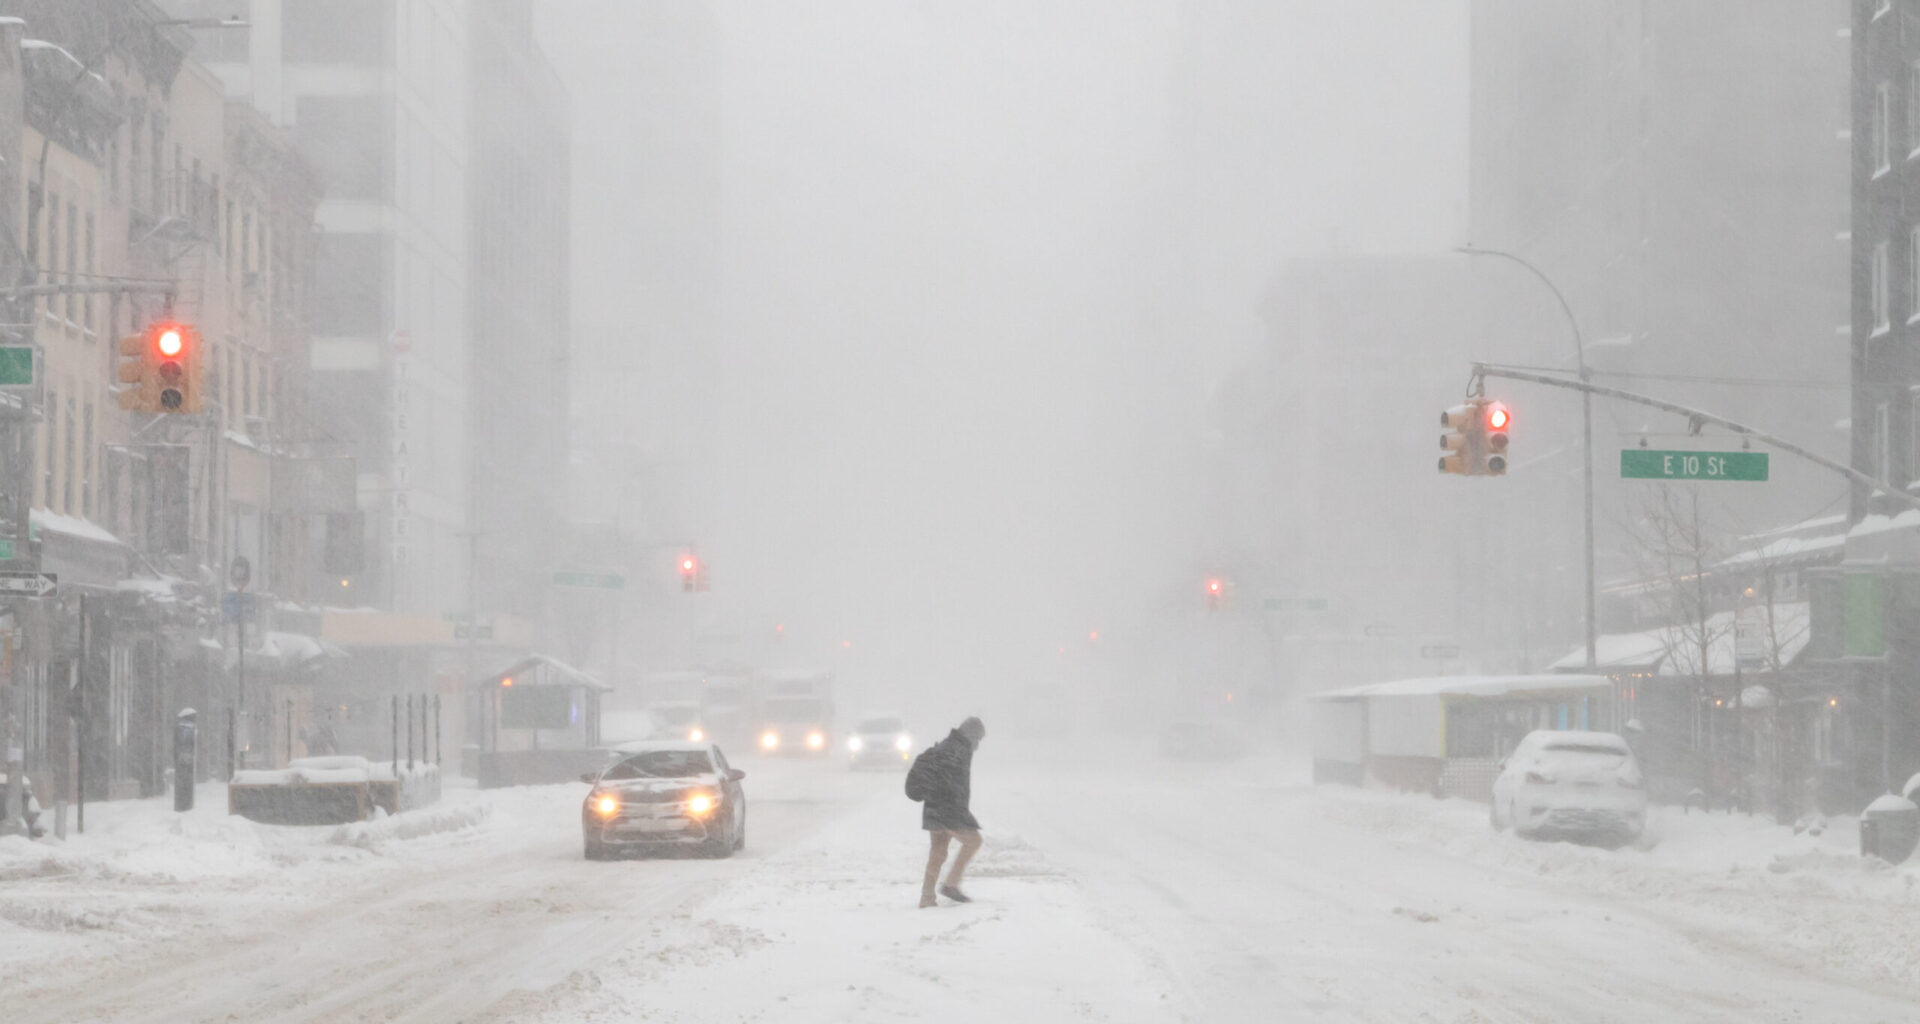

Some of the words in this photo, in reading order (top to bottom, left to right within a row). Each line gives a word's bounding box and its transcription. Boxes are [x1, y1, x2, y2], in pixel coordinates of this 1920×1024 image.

[397, 361, 409, 561] THEATRES
[1663, 455, 1674, 475] E
[1682, 455, 1700, 476] 10
[1707, 456, 1726, 476] St
[24, 579, 47, 589] WAY
